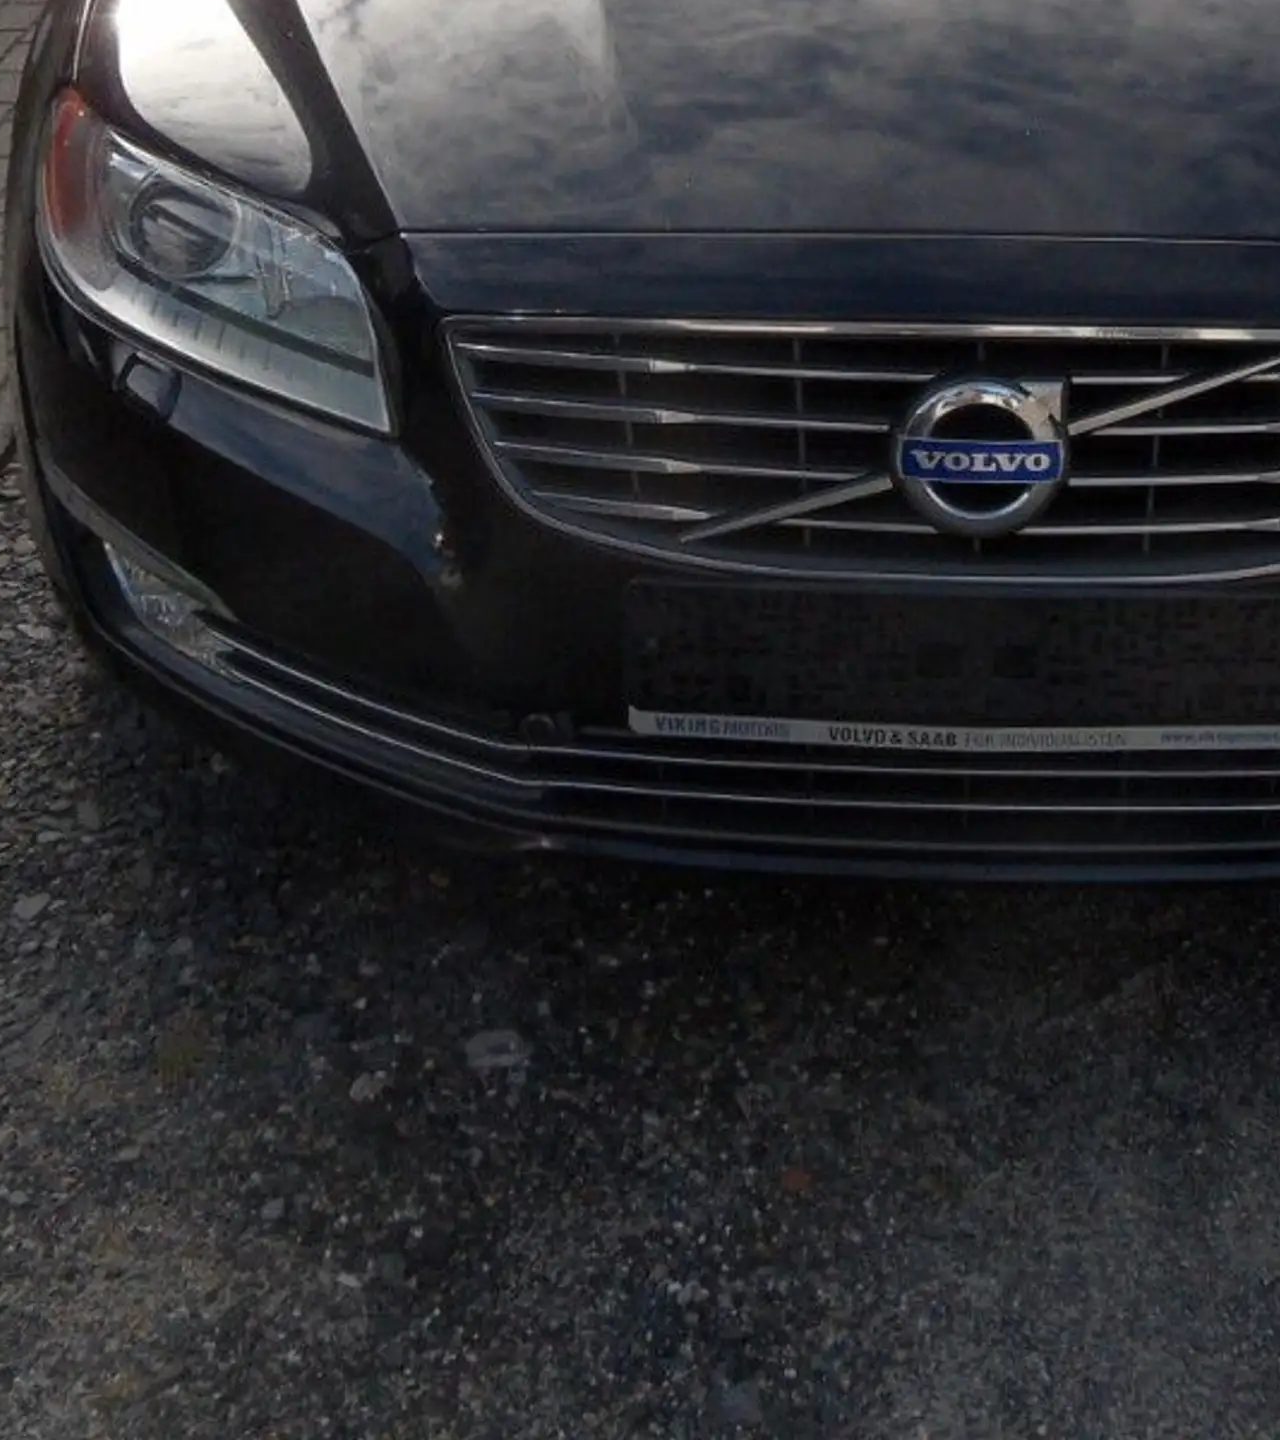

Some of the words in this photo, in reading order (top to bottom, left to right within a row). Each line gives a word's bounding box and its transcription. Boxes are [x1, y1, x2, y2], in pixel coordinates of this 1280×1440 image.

[910, 449, 1051, 472] VOLVO
[655, 714, 721, 735] VIKING
[829, 725, 886, 745] VOLVO
[889, 730, 903, 746] &
[907, 729, 957, 747] SAAB
